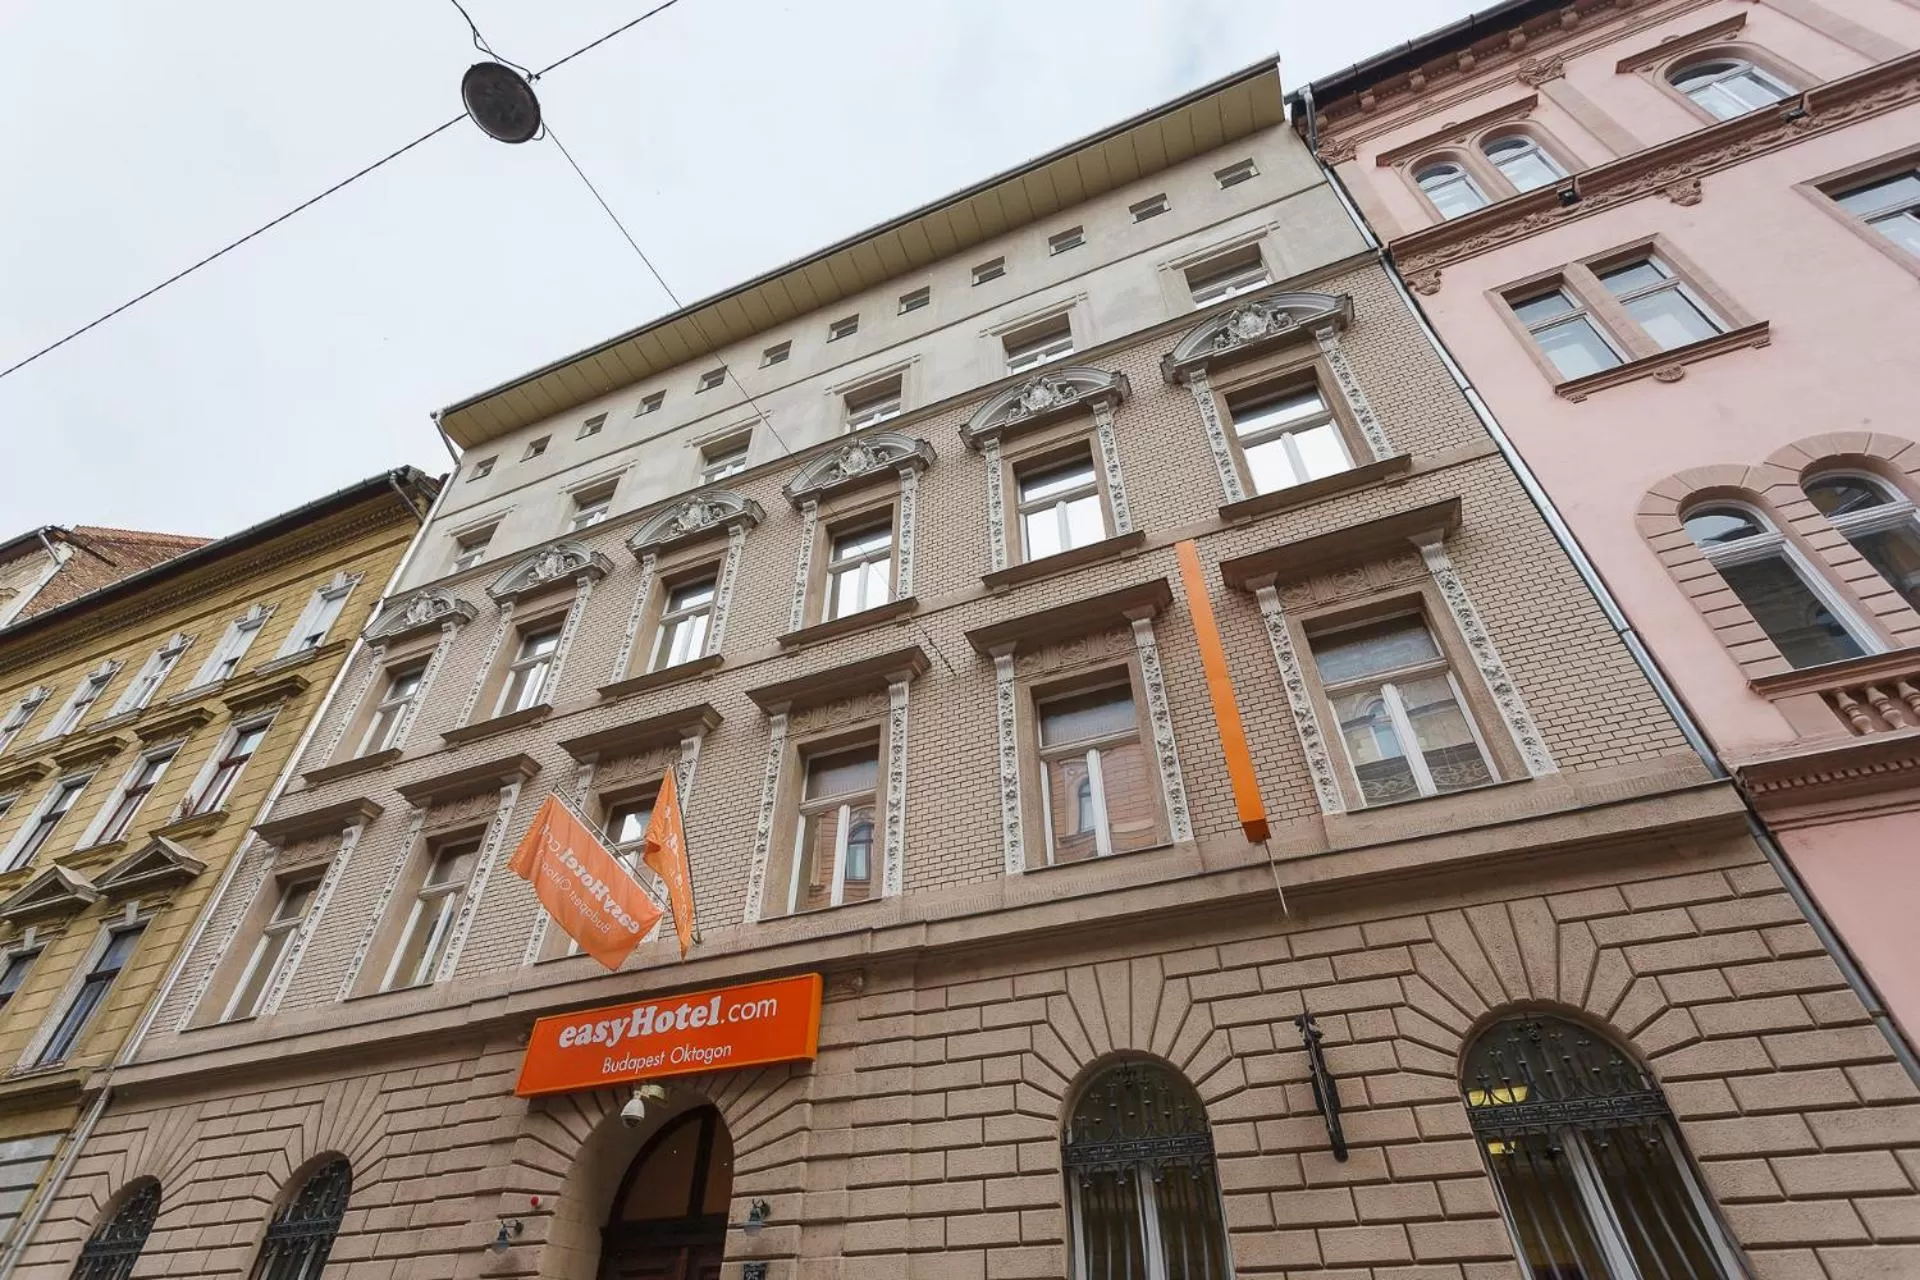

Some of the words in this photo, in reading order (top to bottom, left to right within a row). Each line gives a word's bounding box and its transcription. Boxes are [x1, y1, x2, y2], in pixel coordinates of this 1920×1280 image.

[559, 995, 777, 1048] easyHotel.com
[602, 1051, 665, 1074] Budapest
[670, 1044, 732, 1065] Oktogon
